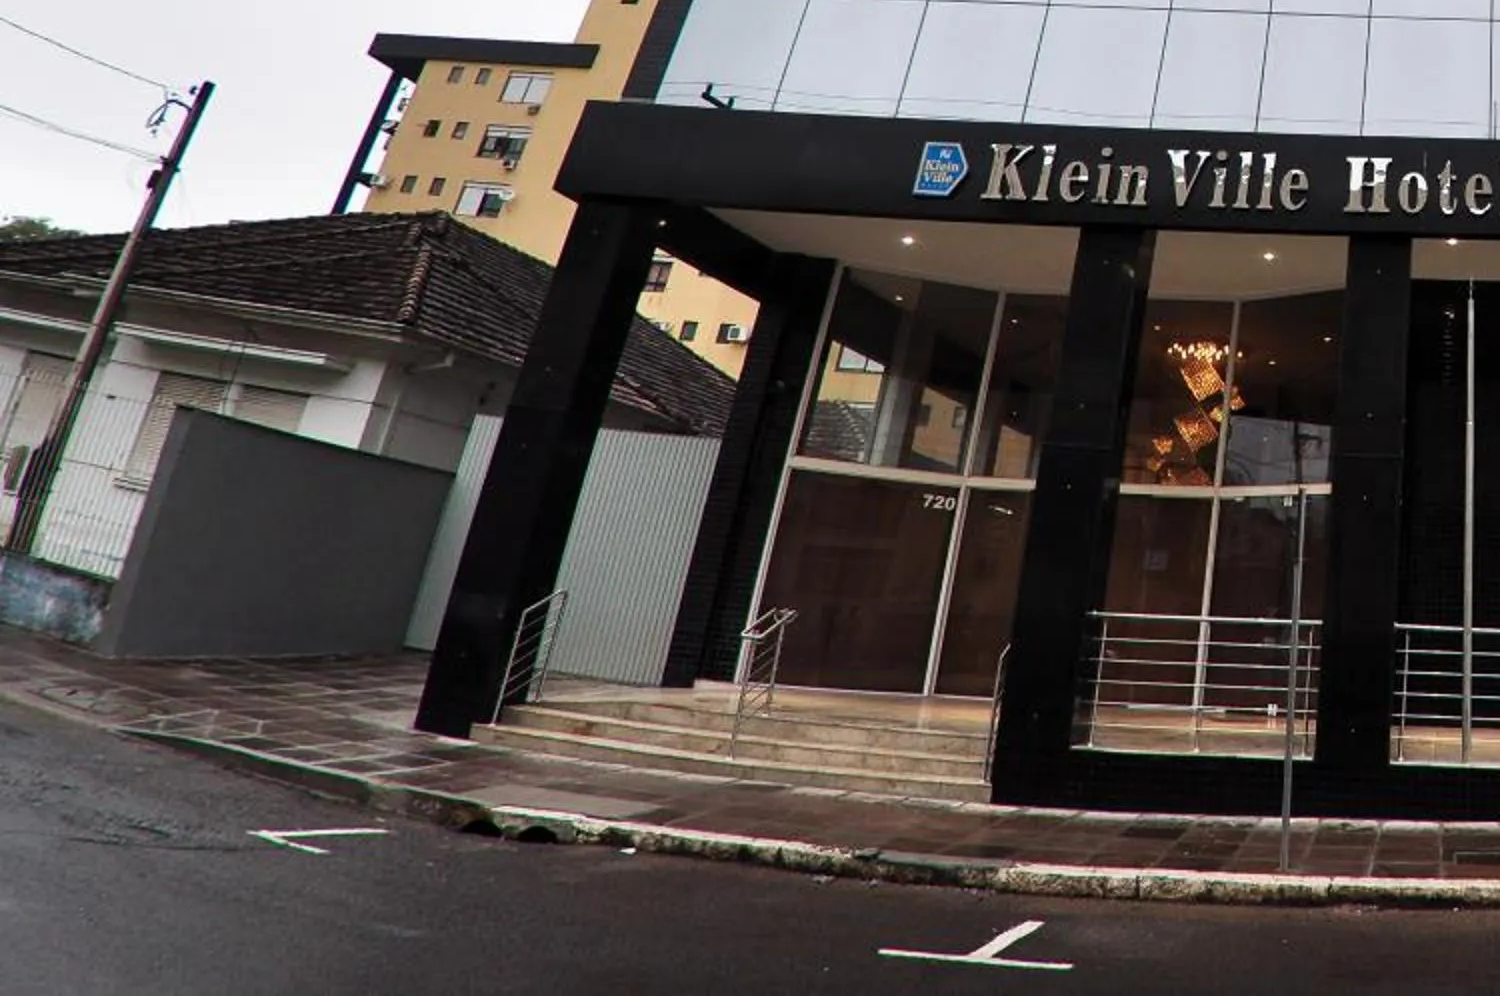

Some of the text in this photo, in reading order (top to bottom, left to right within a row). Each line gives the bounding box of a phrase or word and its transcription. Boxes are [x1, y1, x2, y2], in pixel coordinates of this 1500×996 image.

[980, 143, 1149, 205] Klein
[1167, 149, 1309, 211] Ville
[923, 494, 956, 511] 720
